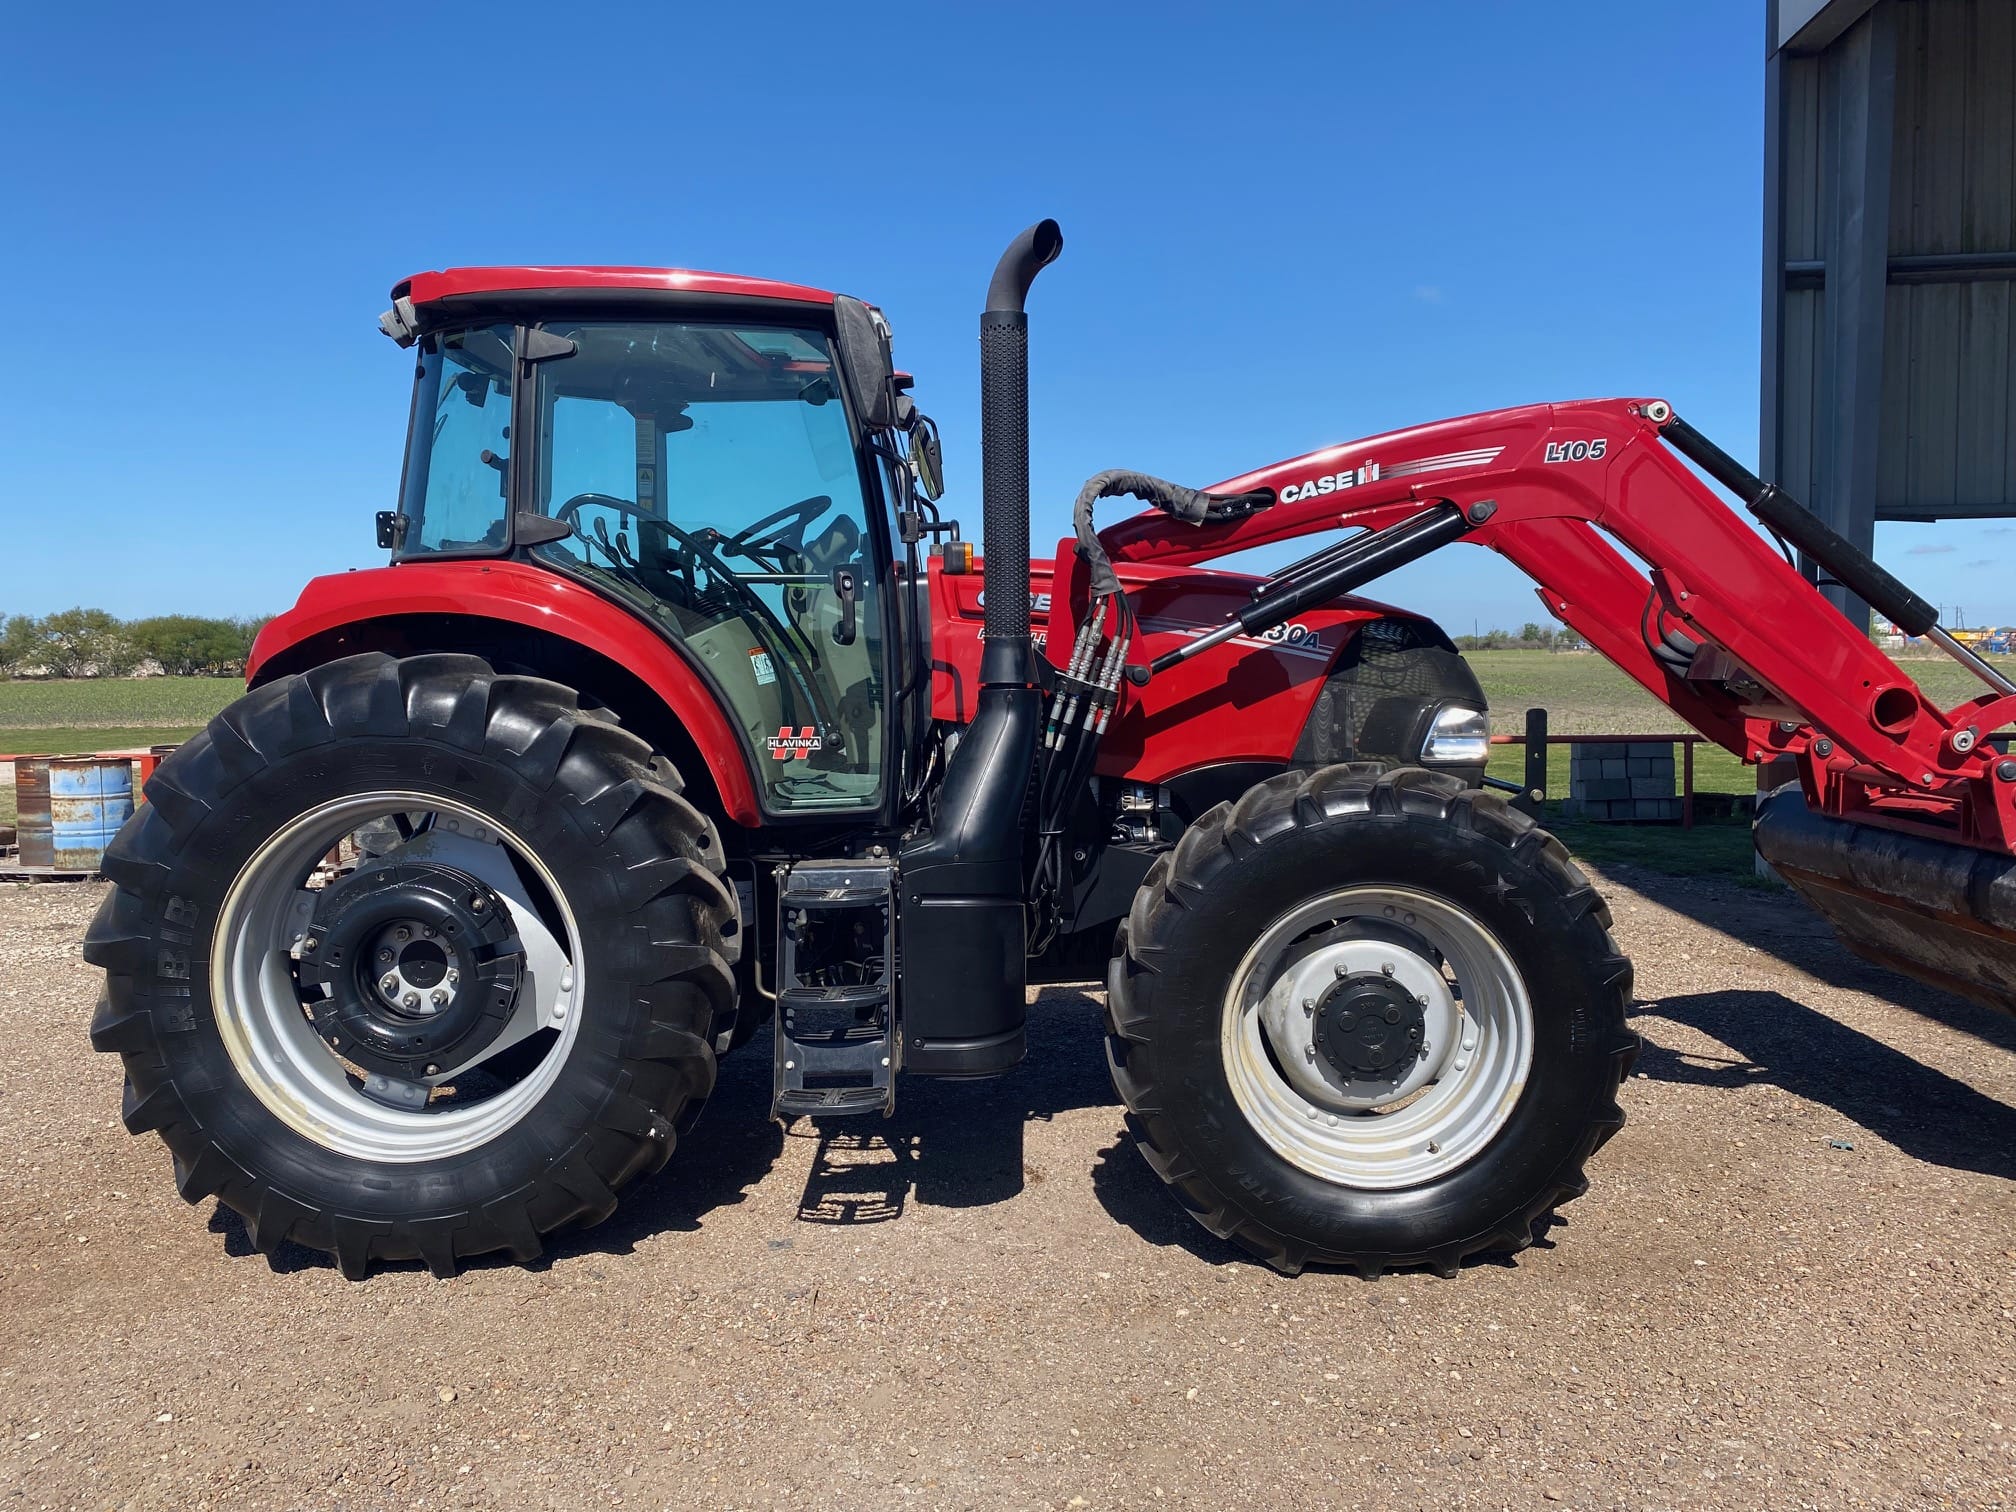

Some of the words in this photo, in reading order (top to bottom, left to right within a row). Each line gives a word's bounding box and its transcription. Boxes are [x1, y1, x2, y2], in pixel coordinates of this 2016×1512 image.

[1544, 439, 1607, 464] L105
[1279, 470, 1353, 504] CASE
[1262, 621, 1320, 649] 30A
[768, 738, 820, 748] HLAVINKA
